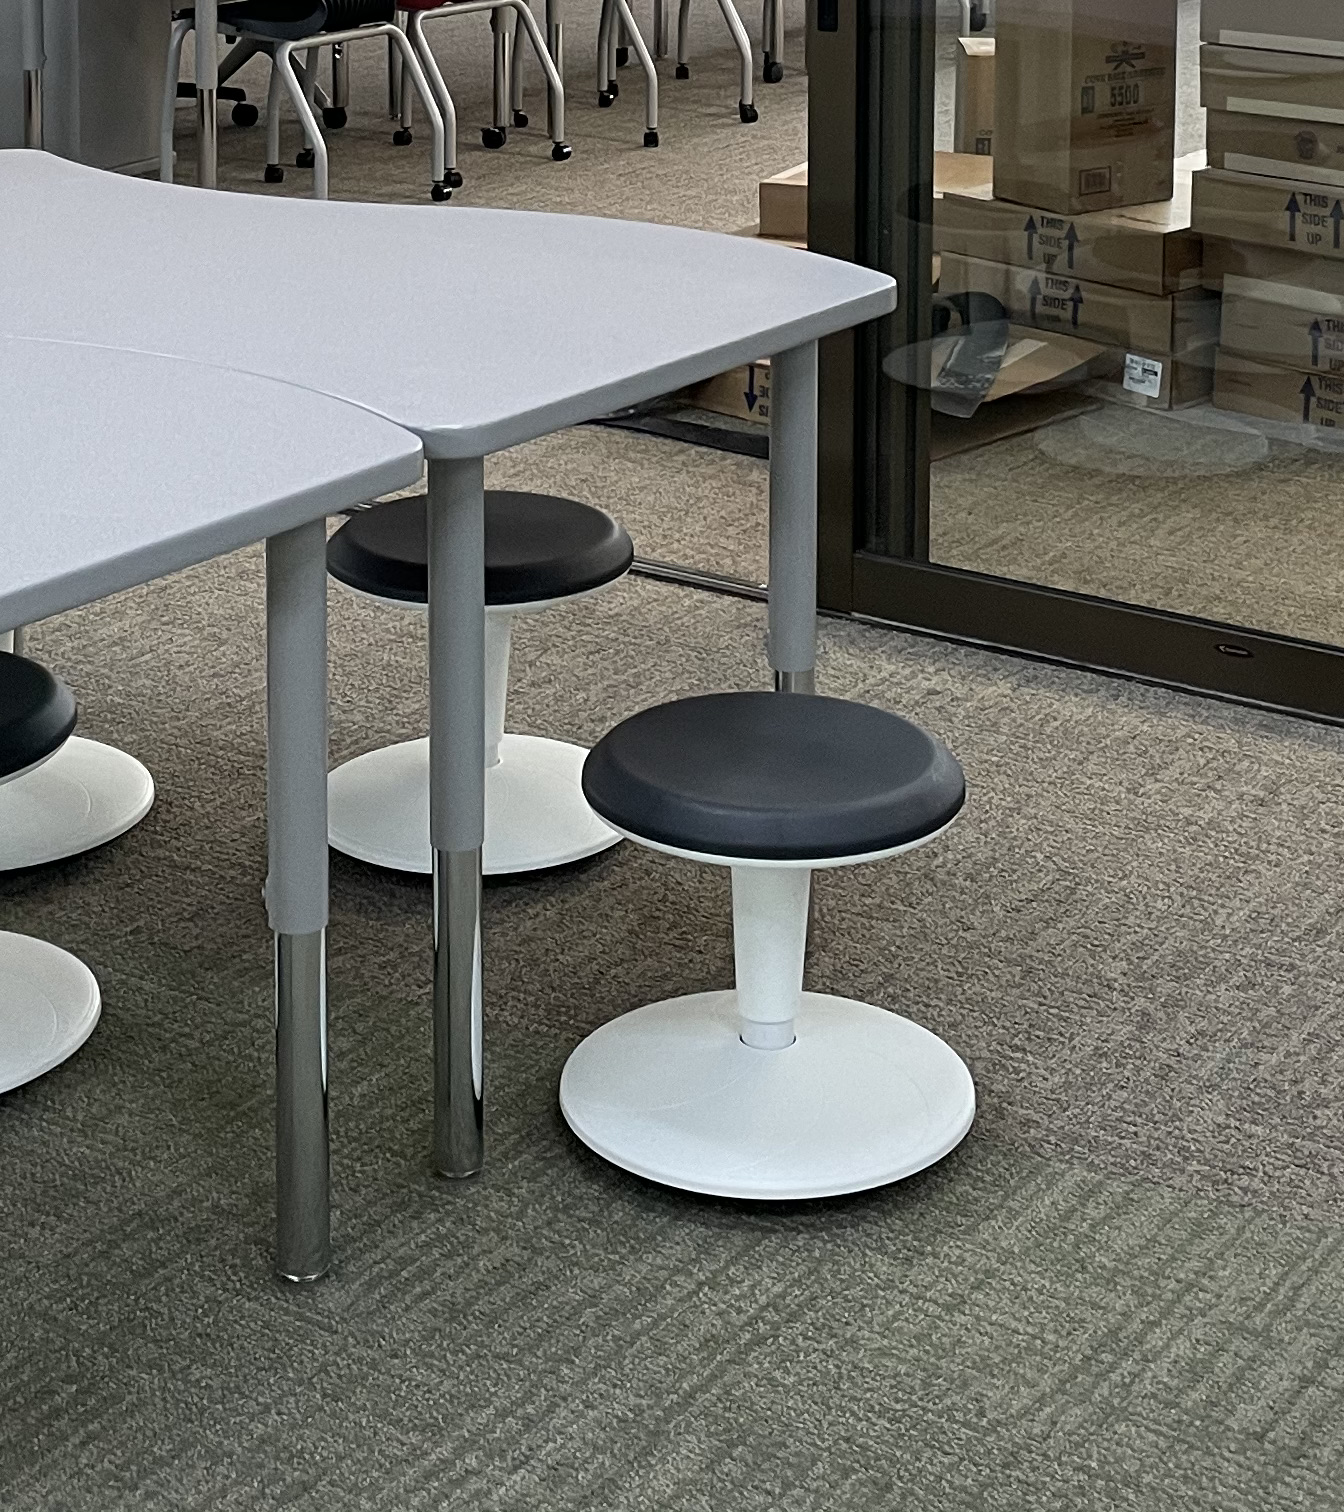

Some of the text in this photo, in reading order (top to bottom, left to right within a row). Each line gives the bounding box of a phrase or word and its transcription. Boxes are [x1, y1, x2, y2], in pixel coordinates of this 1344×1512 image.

[1110, 82, 1140, 107] 5500
[1301, 191, 1329, 209] THIS
[1039, 215, 1065, 231] THIS
[1301, 212, 1329, 228] SIDE
[1038, 233, 1064, 250] SIDE
[1306, 231, 1322, 246] UP
[1045, 276, 1071, 293] THIS
[1041, 296, 1069, 311] SIDE
[1328, 357, 1344, 372] UP
[1317, 376, 1344, 395] THIS
[1315, 396, 1344, 414] SIDE
